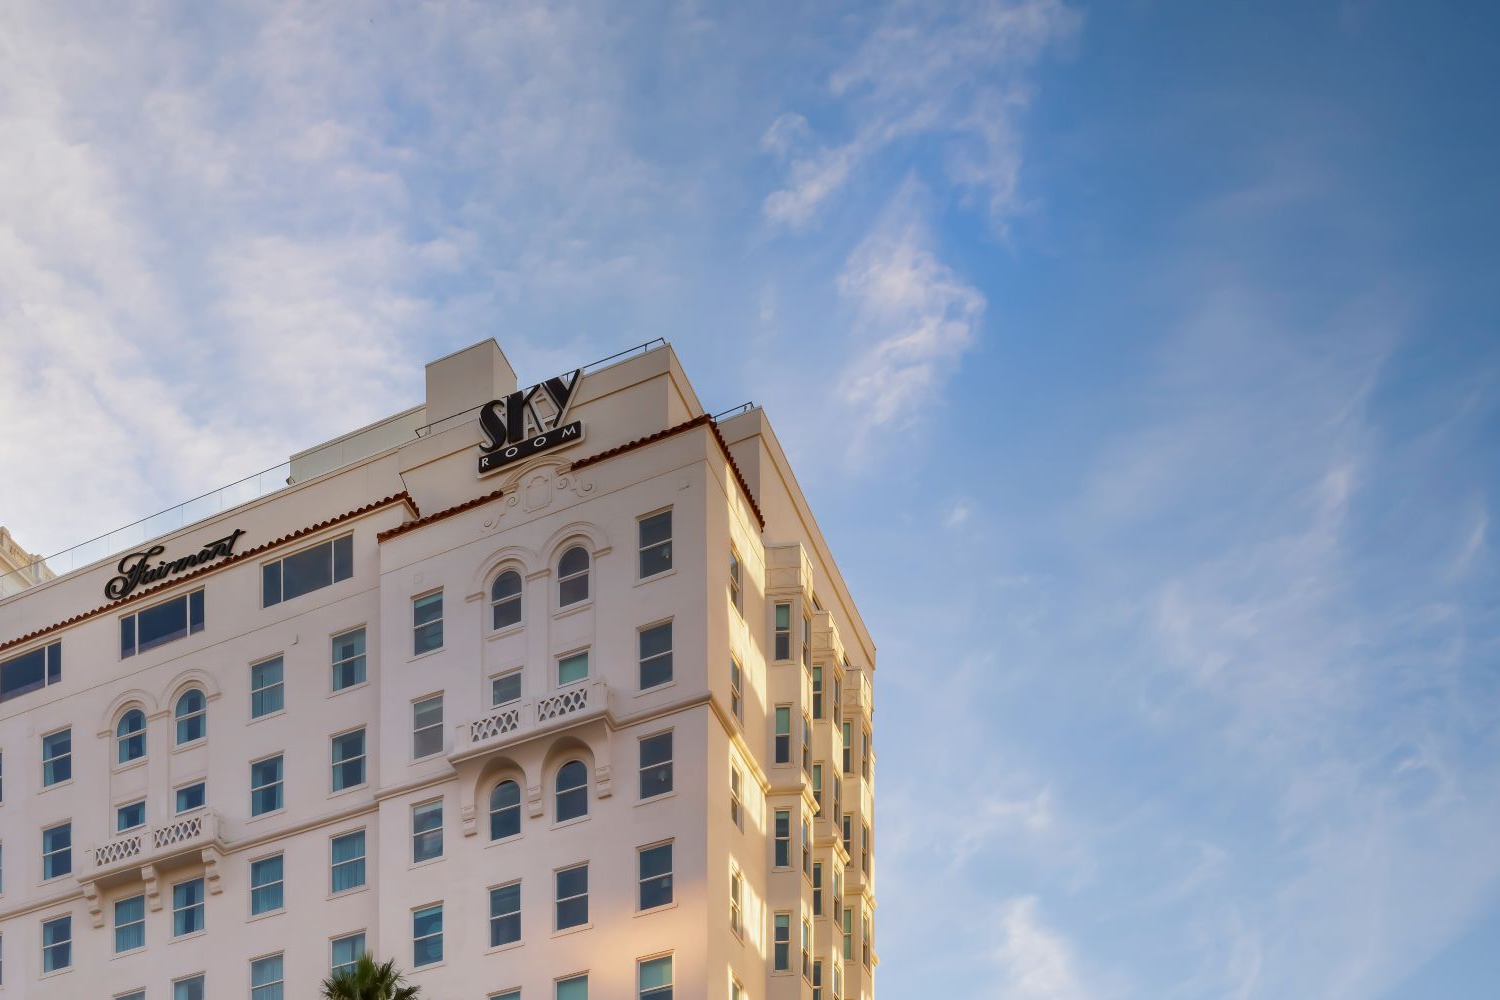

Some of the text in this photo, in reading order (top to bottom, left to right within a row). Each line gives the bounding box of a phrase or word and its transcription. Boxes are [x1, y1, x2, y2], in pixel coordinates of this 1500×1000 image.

[479, 368, 581, 452] SKY
[481, 426, 576, 467] ROOM
[104, 529, 246, 600] Fairmont
